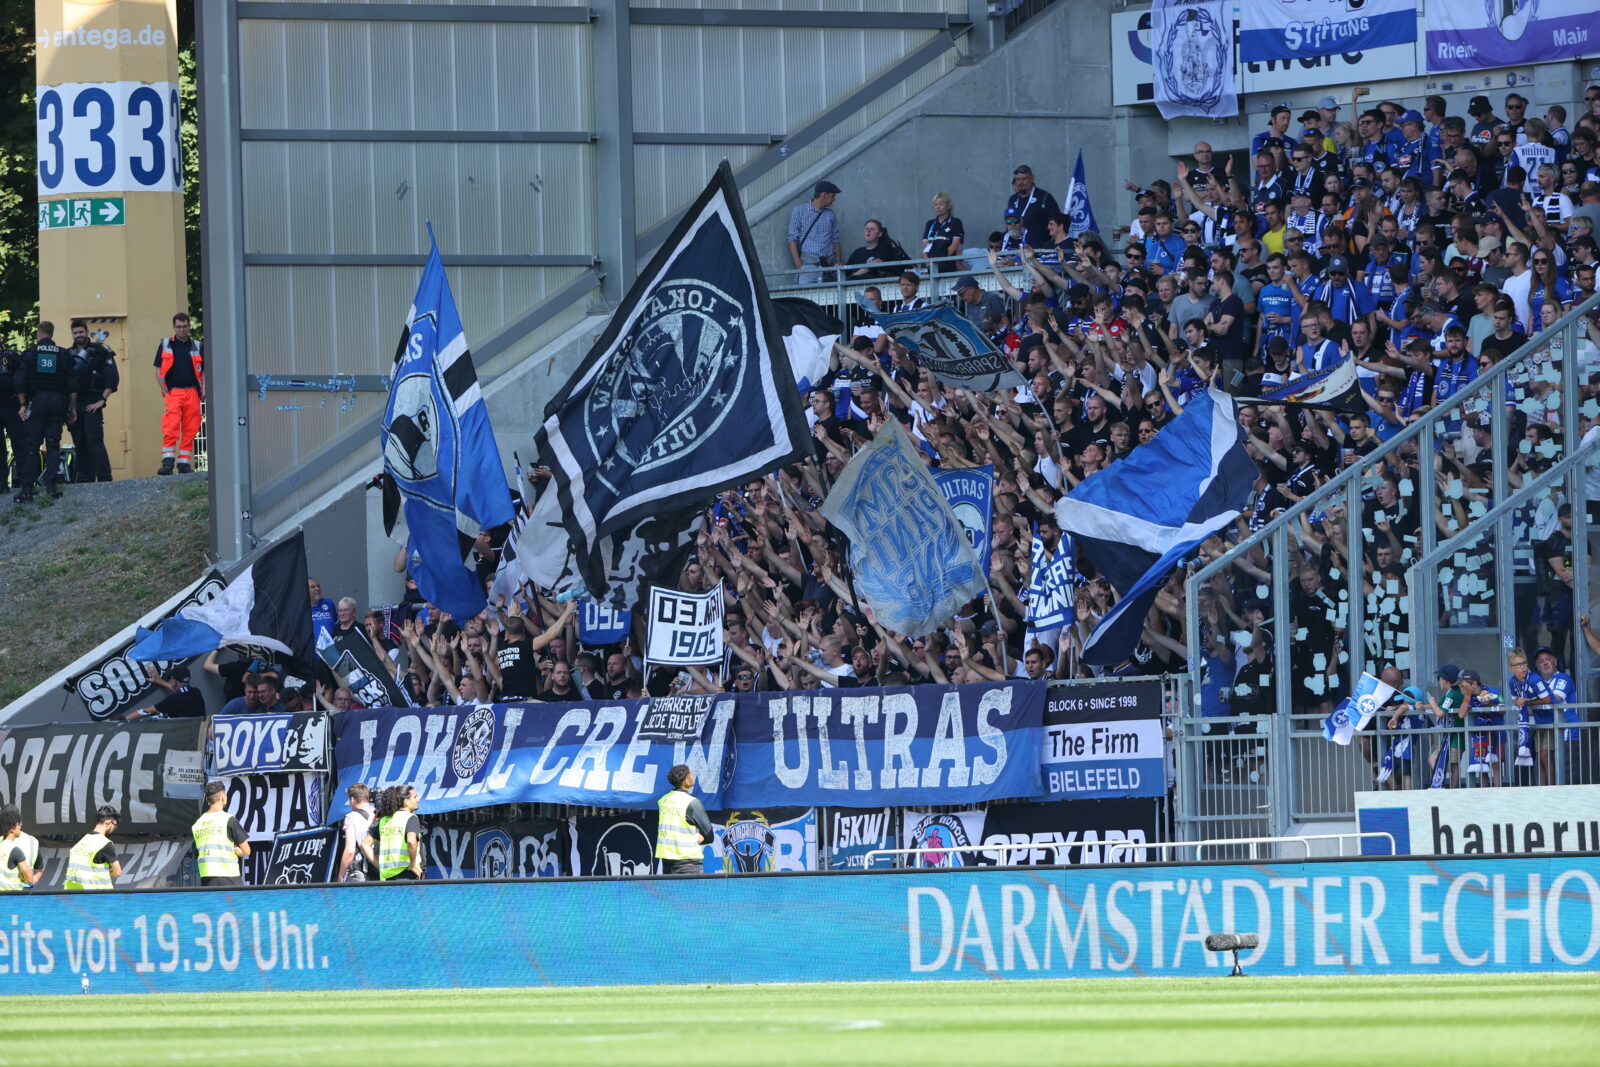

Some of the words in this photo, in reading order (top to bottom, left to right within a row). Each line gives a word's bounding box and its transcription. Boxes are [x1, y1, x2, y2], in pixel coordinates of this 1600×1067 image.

[53, 24, 166, 50] entega.de
[38, 89, 64, 190] 3
[72, 87, 116, 187] 3
[127, 86, 166, 186] 3
[37, 345, 60, 353] POLIZEI
[41, 358, 53, 368] 38
[669, 627, 717, 658] 1905
[1048, 699, 1077, 713] BLOCK
[1078, 699, 1083, 711] 6
[1090, 697, 1117, 710] SINCE
[1118, 695, 1137, 708] 1998
[214, 719, 288, 769] BOYS
[768, 685, 1013, 791] ULTRAS
[1048, 730, 1085, 758] The
[1092, 727, 1139, 755] Firm
[0, 731, 163, 825] SPENGE
[1048, 767, 1141, 793] BIELEFELD
[224, 773, 311, 833] ORTA
[847, 855, 875, 868] ULTRS
[907, 874, 1392, 974] DARMSTÄDTER
[1408, 868, 1600, 968] ECHO
[64, 926, 121, 974] vor
[133, 910, 242, 973] 19.30
[252, 909, 329, 971] Uhr.
